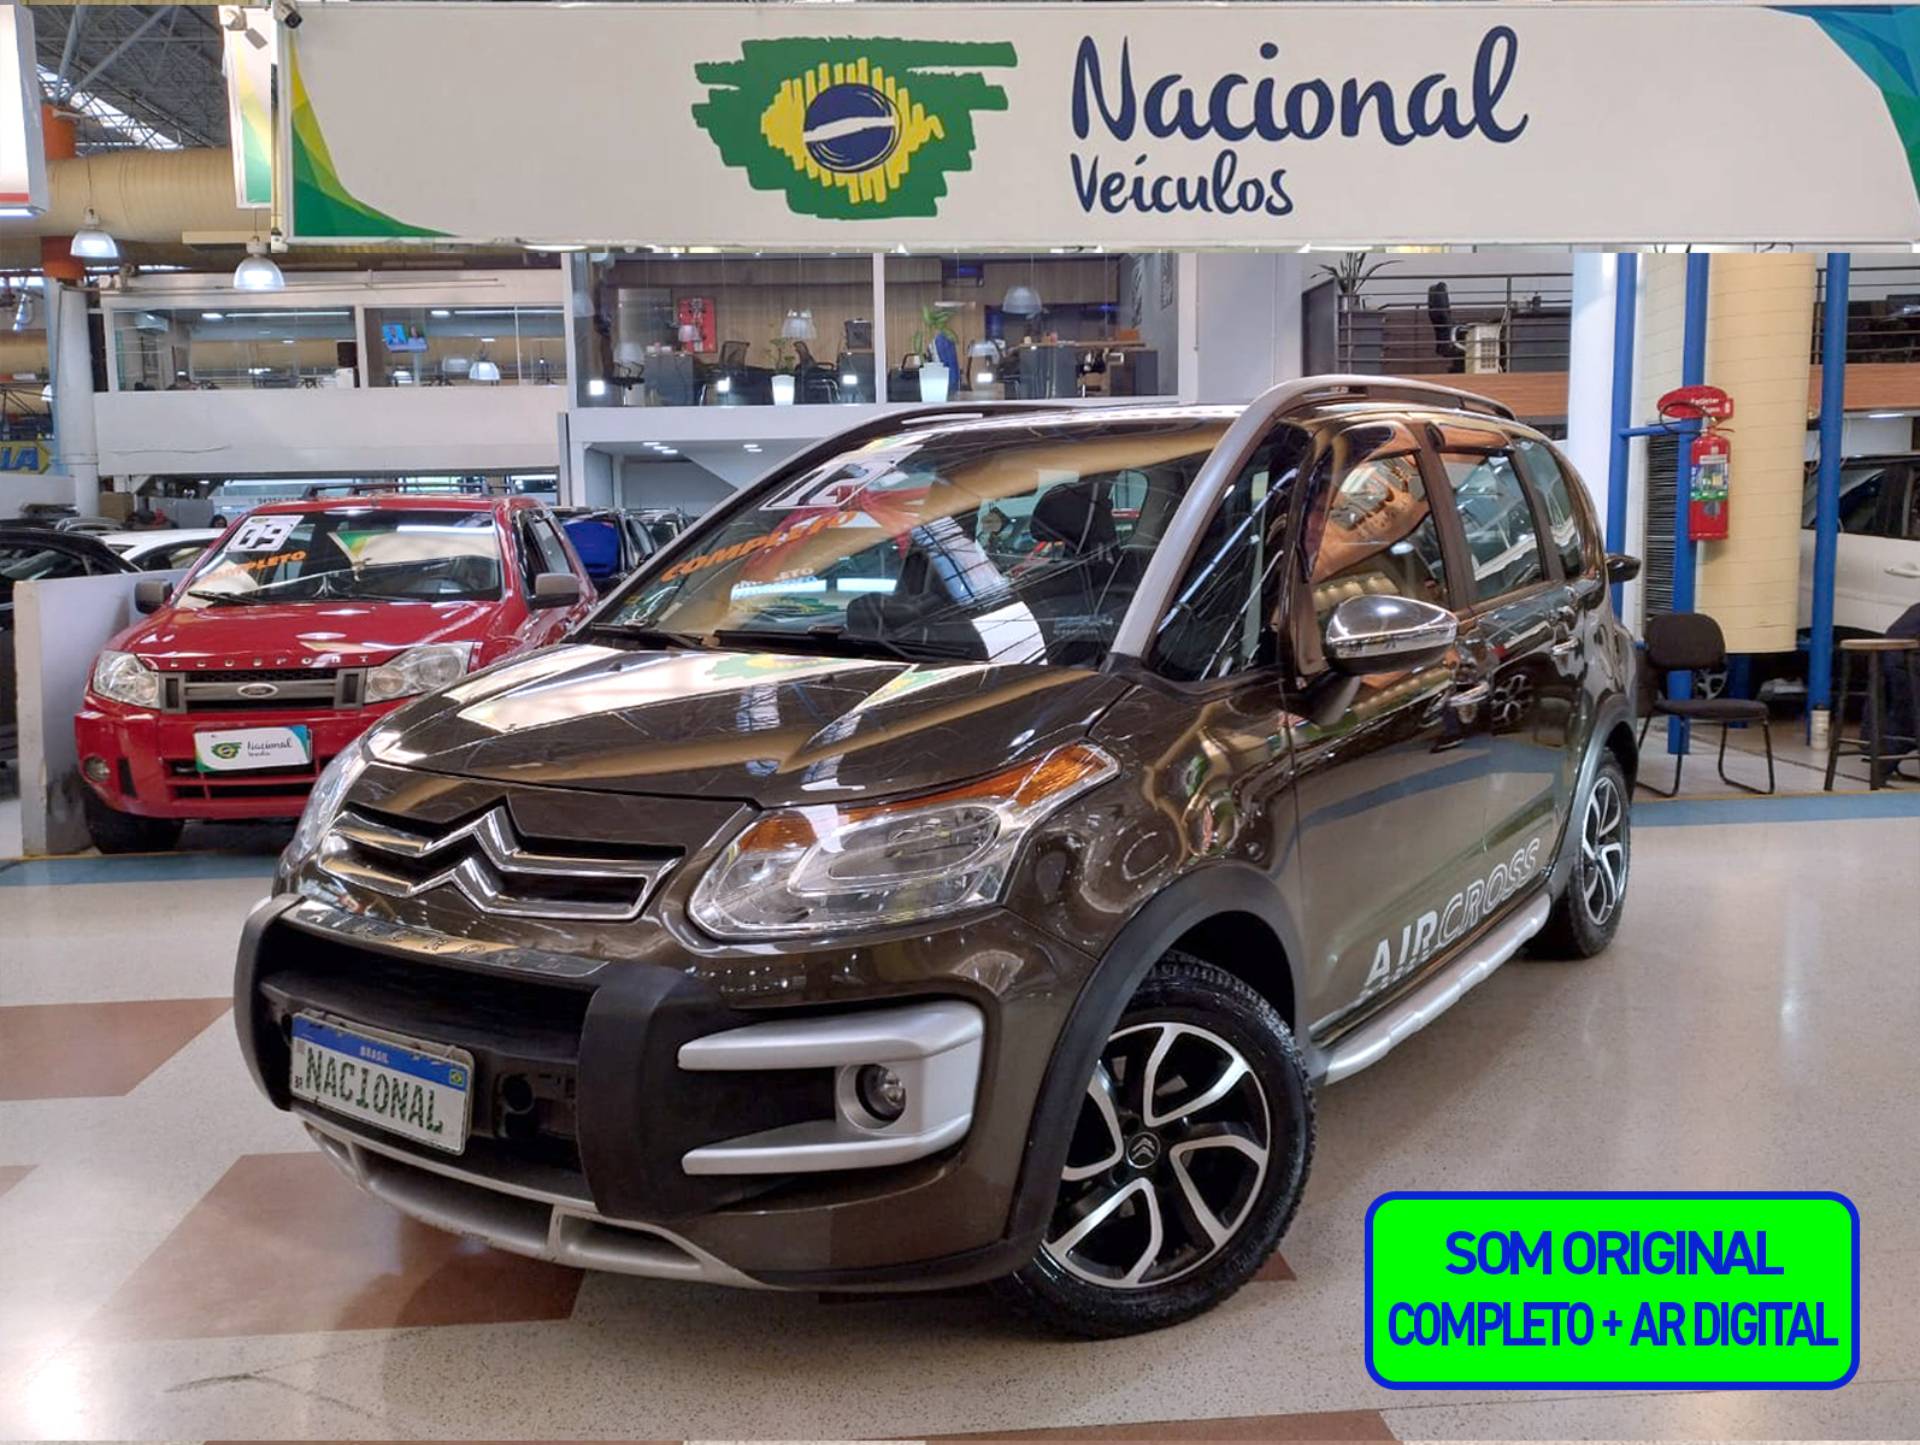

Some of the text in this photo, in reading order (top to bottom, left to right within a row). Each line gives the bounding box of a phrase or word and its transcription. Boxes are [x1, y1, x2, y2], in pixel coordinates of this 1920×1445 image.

[1072, 25, 1529, 146] Nacional
[1071, 149, 1294, 216] Veículos
[660, 511, 858, 582] COMPLETO
[1363, 837, 1541, 988] AIRCROSS
[305, 1047, 444, 1134] NACIONAL
